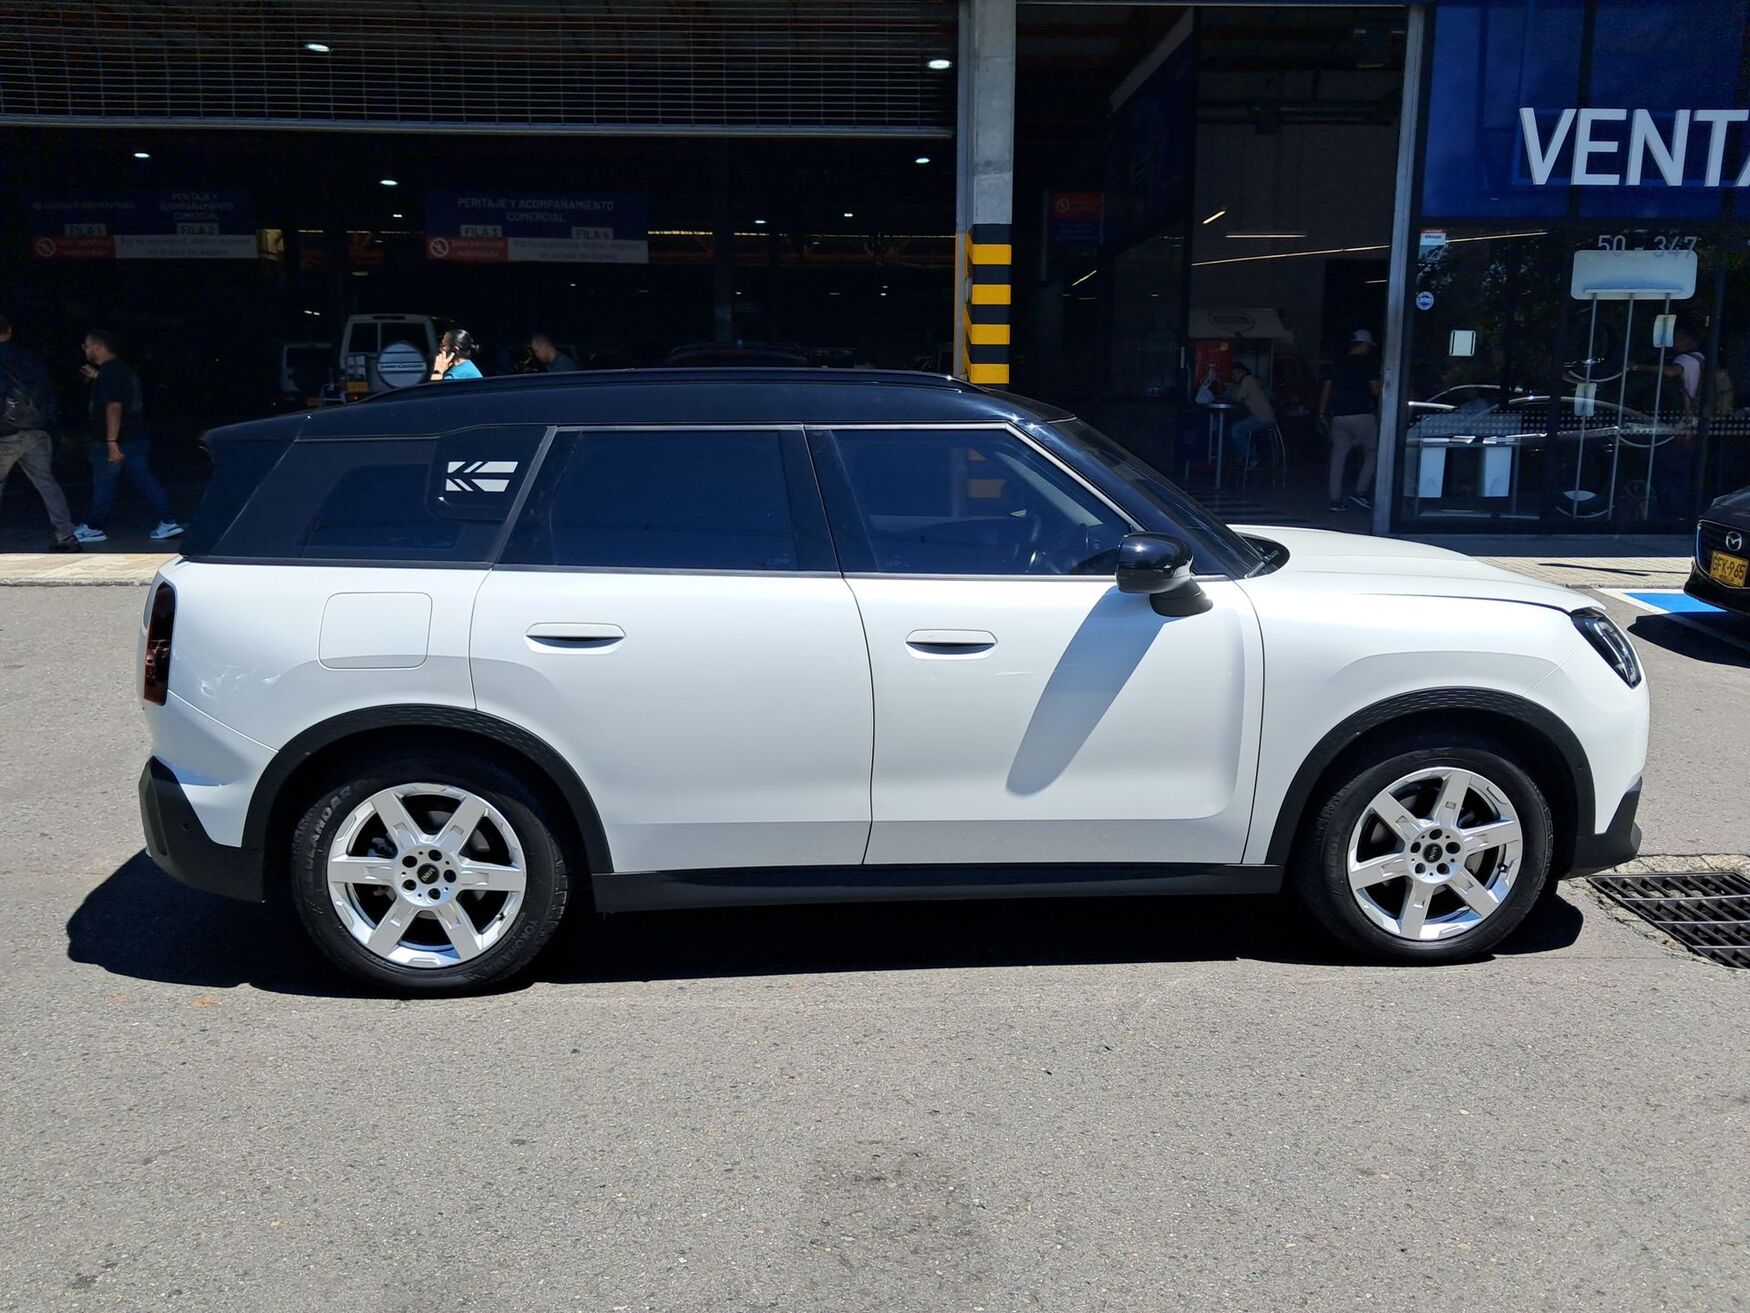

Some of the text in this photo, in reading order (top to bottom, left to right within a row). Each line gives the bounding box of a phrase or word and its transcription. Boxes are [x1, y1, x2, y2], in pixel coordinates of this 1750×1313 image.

[1519, 107, 1750, 187] VENT
[457, 198, 507, 209] PERITAJE
[518, 198, 614, 211] ACOMPAÑAMIENTO
[506, 211, 566, 223] COMERCIAL
[1598, 234, 1626, 252] 50
